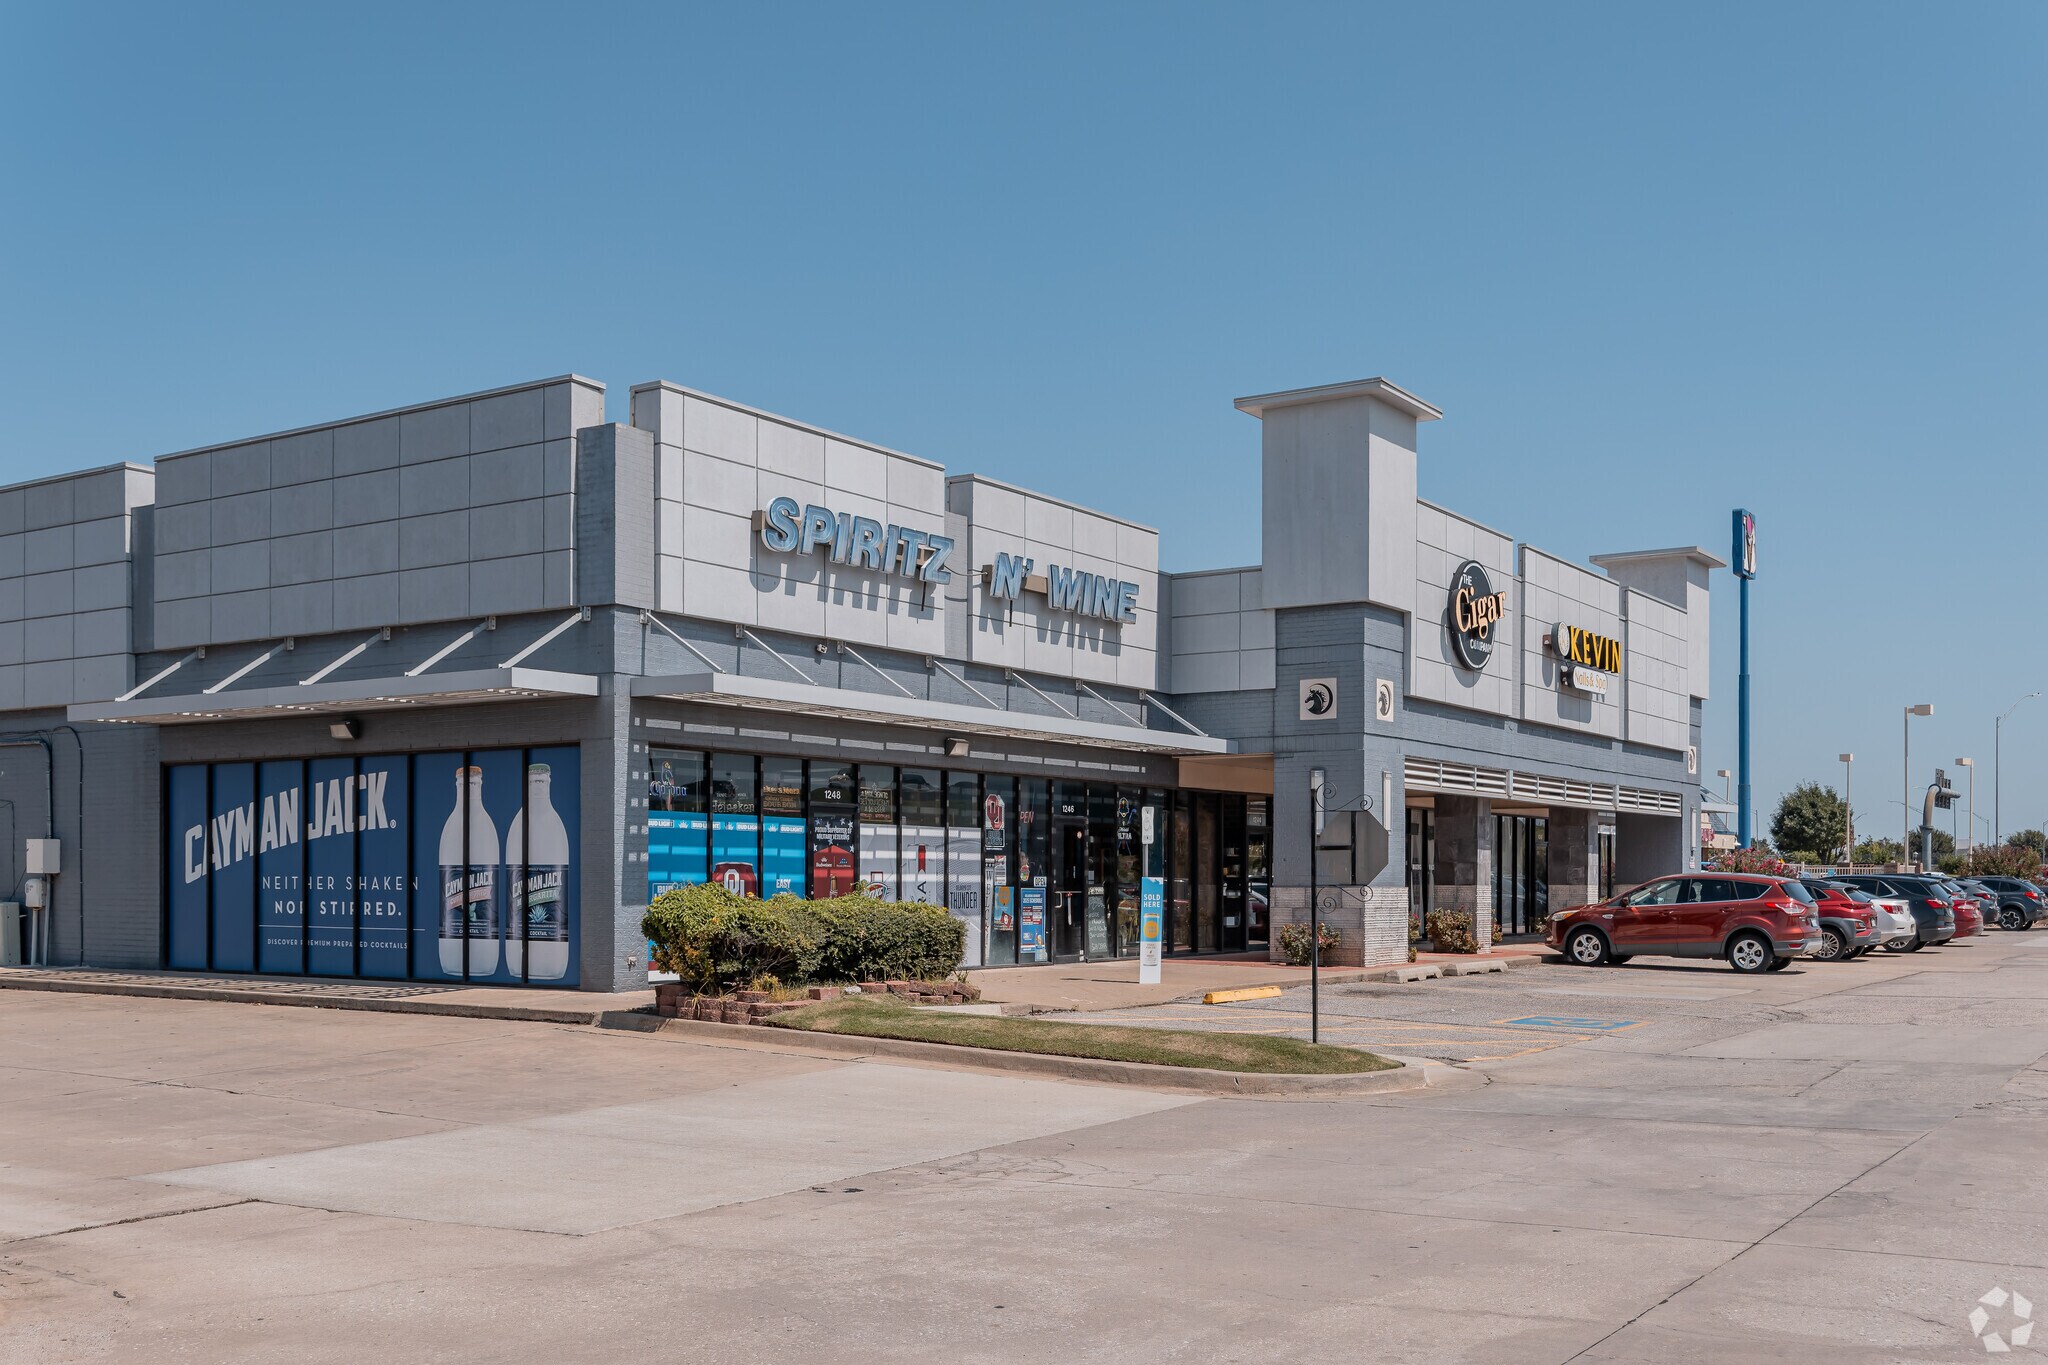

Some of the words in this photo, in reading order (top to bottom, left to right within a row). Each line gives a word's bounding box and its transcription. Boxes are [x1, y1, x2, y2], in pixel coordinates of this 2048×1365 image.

[761, 496, 955, 585] SPIRITZ
[1462, 573, 1473, 586] THE
[1047, 564, 1140, 625] WINE
[1455, 586, 1507, 639] Cigar
[1570, 625, 1622, 674] KEVIN
[824, 790, 841, 800] 1248
[1019, 811, 1035, 824] PEN
[1062, 805, 1075, 813] 1246
[185, 787, 299, 885] CAYMAN
[345, 876, 419, 891] SHAKEN
[445, 874, 475, 898] CAYMN
[475, 870, 494, 887] JACK
[542, 871, 563, 888] JACK
[775, 878, 792, 889] EASY
[949, 891, 978, 909] THUNDER
[267, 938, 298, 946] DISCOVER
[333, 940, 368, 949] PREPAED
[370, 941, 408, 950] COCKTAILS
